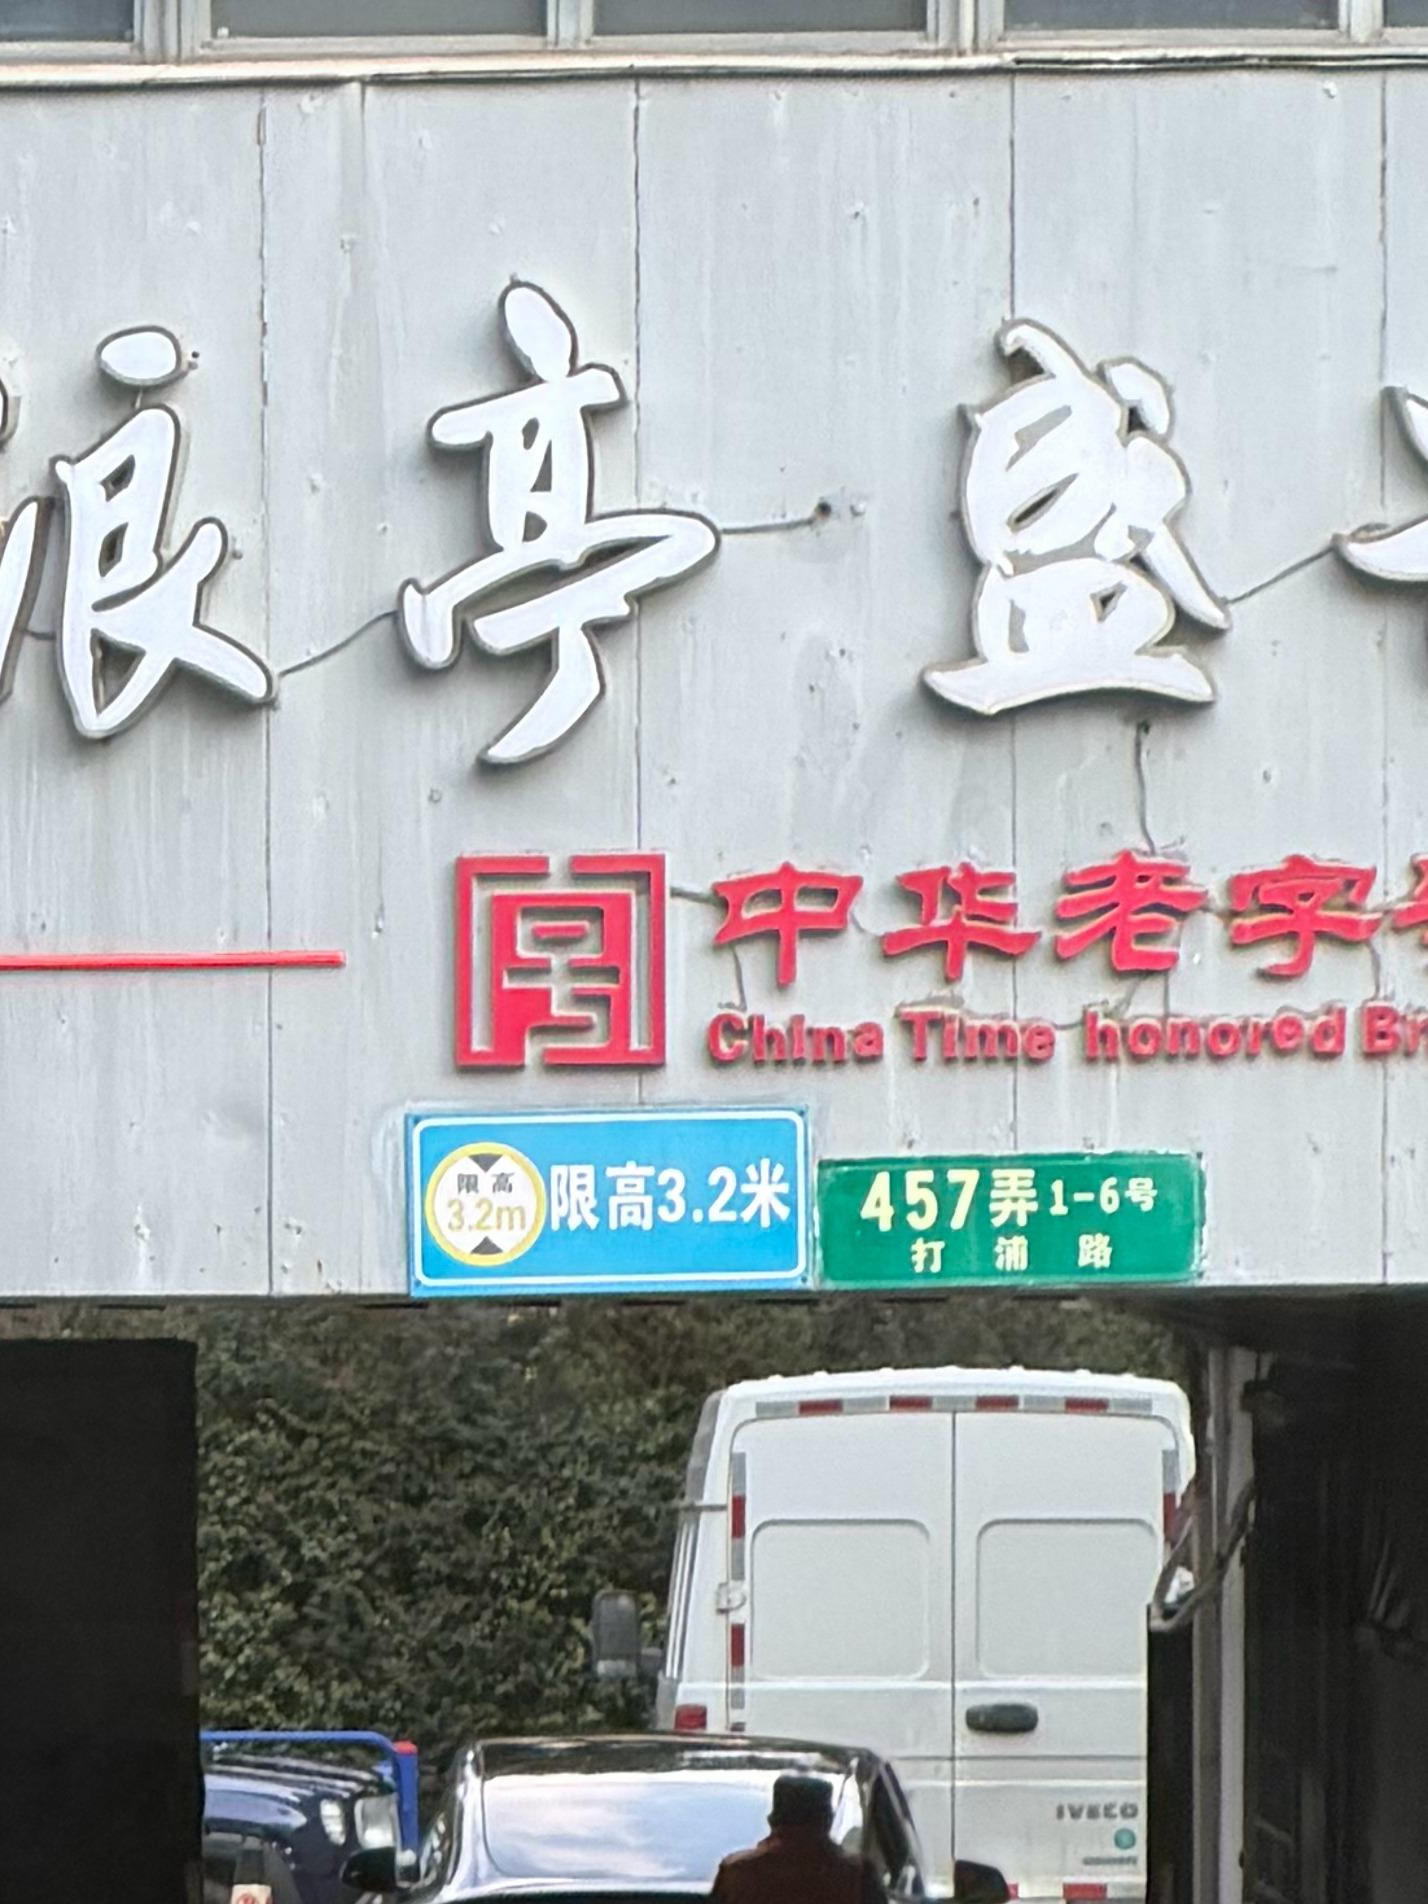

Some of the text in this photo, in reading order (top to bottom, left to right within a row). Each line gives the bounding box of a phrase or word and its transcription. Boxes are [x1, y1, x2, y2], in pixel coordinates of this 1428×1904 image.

[712, 850, 1428, 985] 中华老字
[705, 1009, 886, 1066] China
[901, 1009, 1056, 1066] Time
[1084, 1004, 1346, 1062] honored
[456, 1172, 514, 1196] 限高
[549, 1157, 792, 1232] 限高3.2米
[445, 1198, 528, 1234] 3.2m
[910, 1234, 1114, 1274] 打浦路
[1056, 1802, 1139, 1820] IVECO
